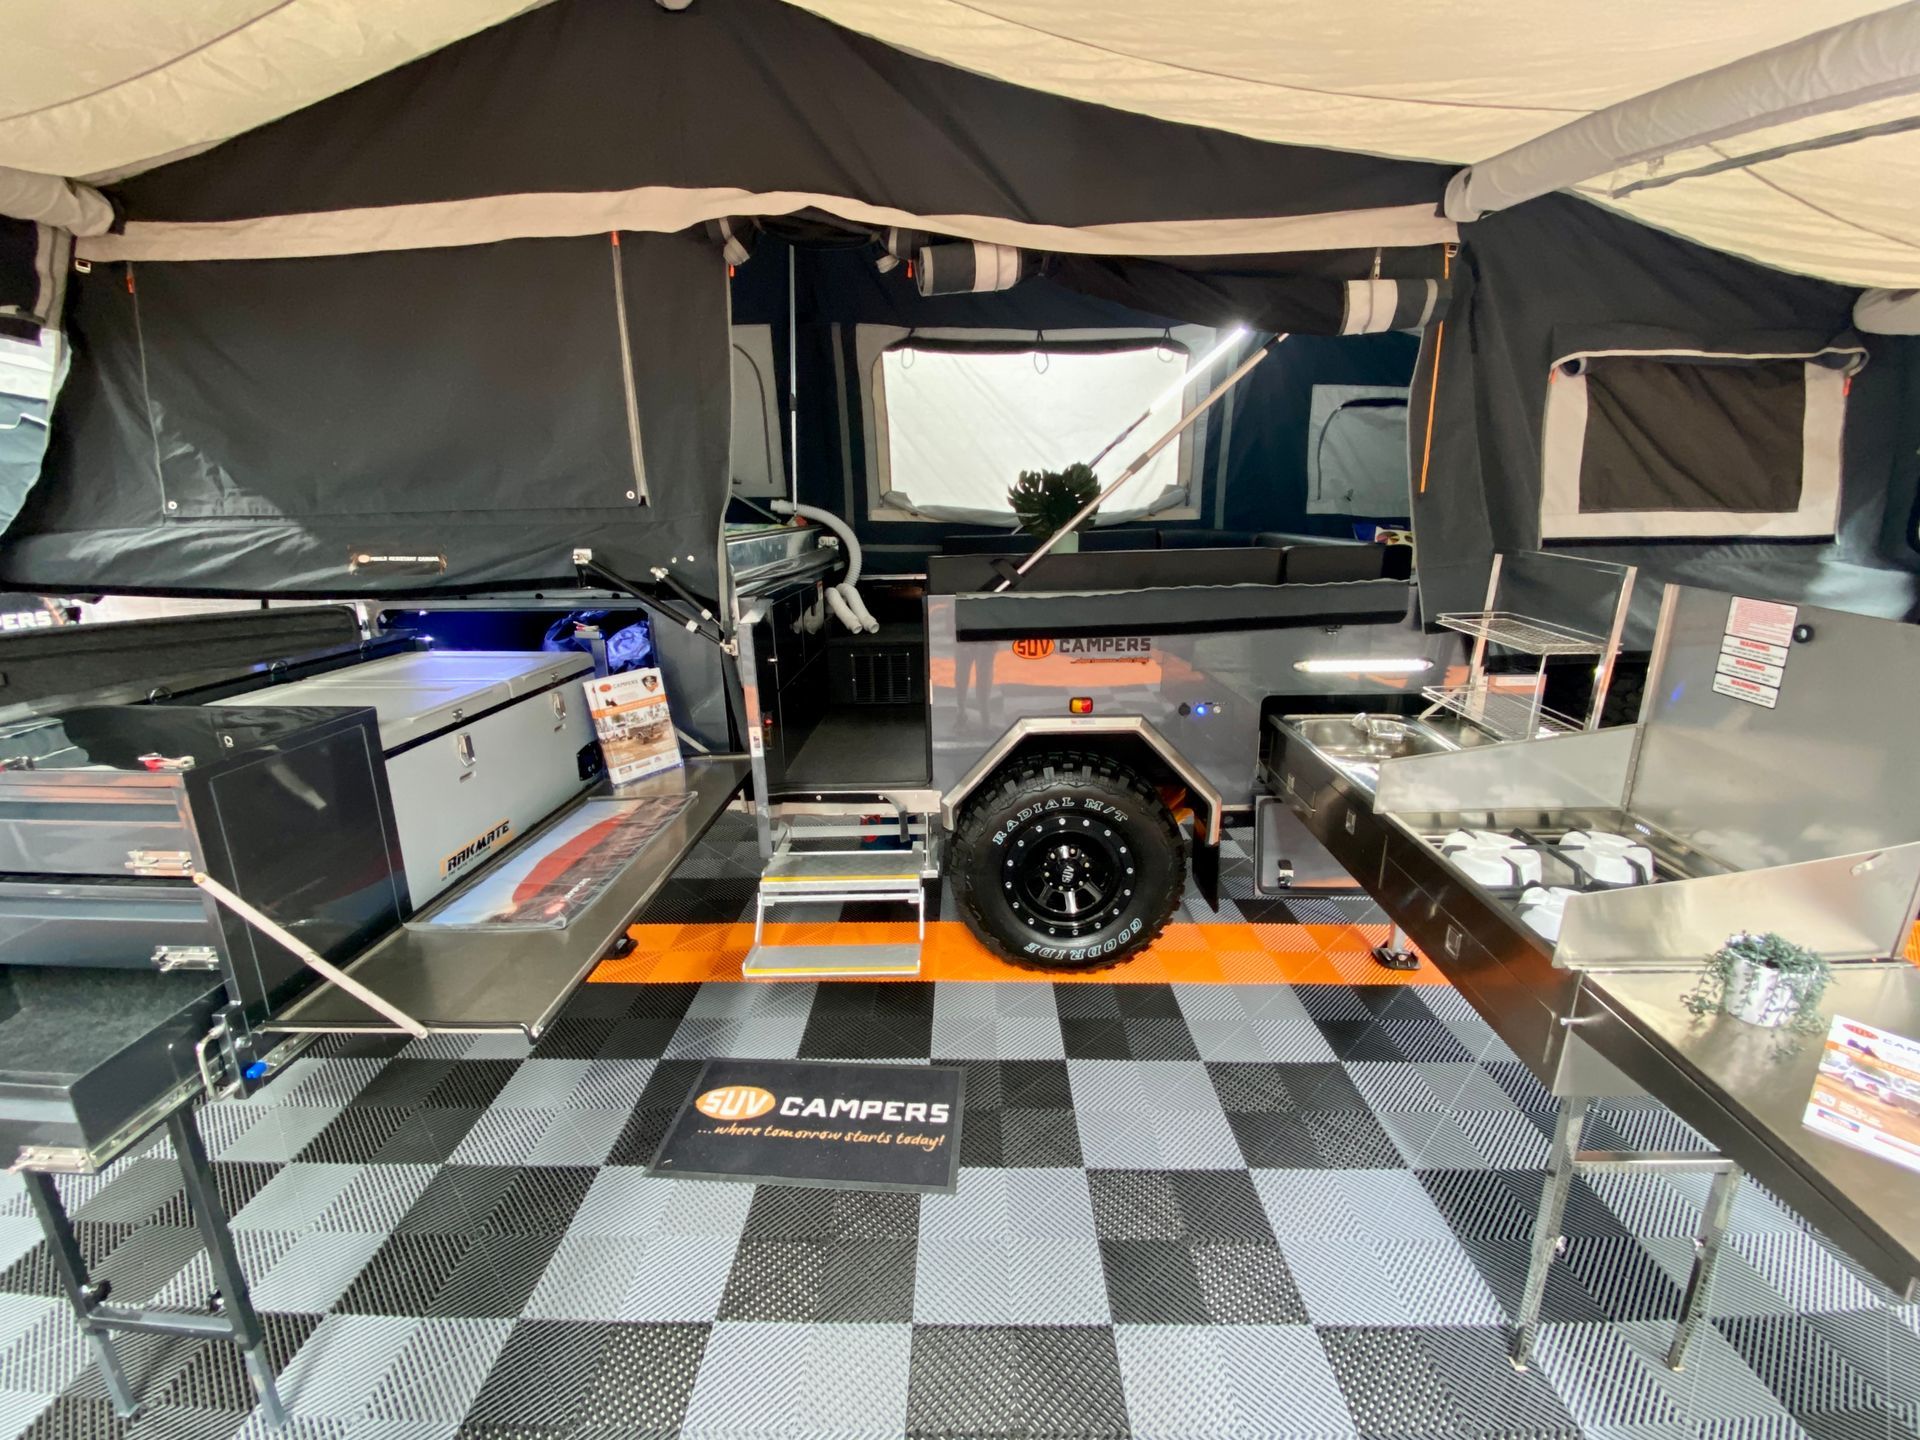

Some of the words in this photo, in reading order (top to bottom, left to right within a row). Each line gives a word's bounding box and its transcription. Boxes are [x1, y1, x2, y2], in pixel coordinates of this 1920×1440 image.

[1017, 639, 1051, 656] SUV
[1059, 638, 1151, 653] CAMPERS
[992, 796, 1075, 846] RADIAL
[1085, 797, 1130, 823] M/T
[1023, 917, 1144, 961] GOODRIDE
[702, 1089, 768, 1117] SUV
[779, 1096, 950, 1123] CAMPERS
[763, 1125, 842, 1142] tomorrow
[844, 1130, 892, 1146] starts
[896, 1134, 946, 1152] today!
